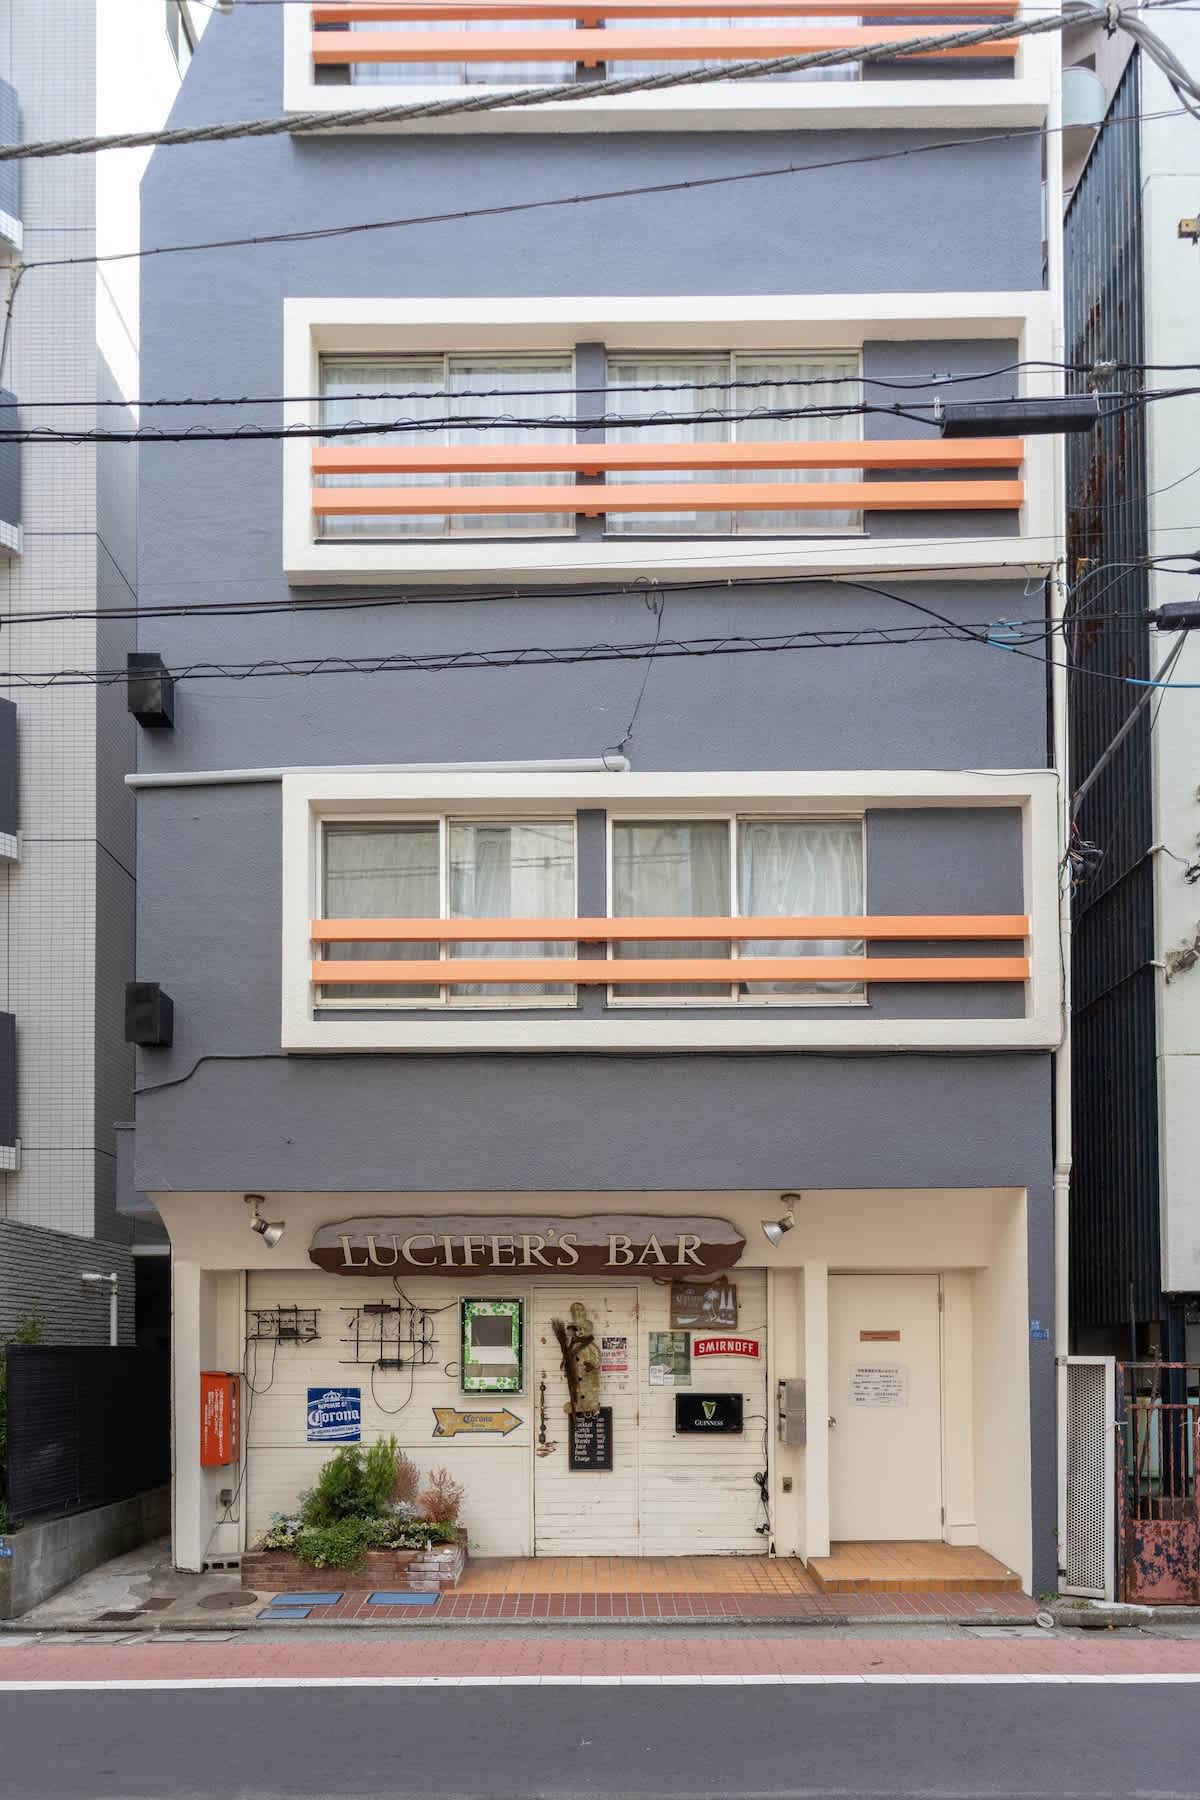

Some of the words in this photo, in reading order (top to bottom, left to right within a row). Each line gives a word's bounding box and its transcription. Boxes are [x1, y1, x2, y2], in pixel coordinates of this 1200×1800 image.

[338, 1229, 579, 1268] LUCIFER'S
[604, 1233, 706, 1267] BAR
[699, 1341, 754, 1353] SMIRNOFF
[308, 1409, 360, 1428] Corona
[463, 1414, 494, 1424] Corona
